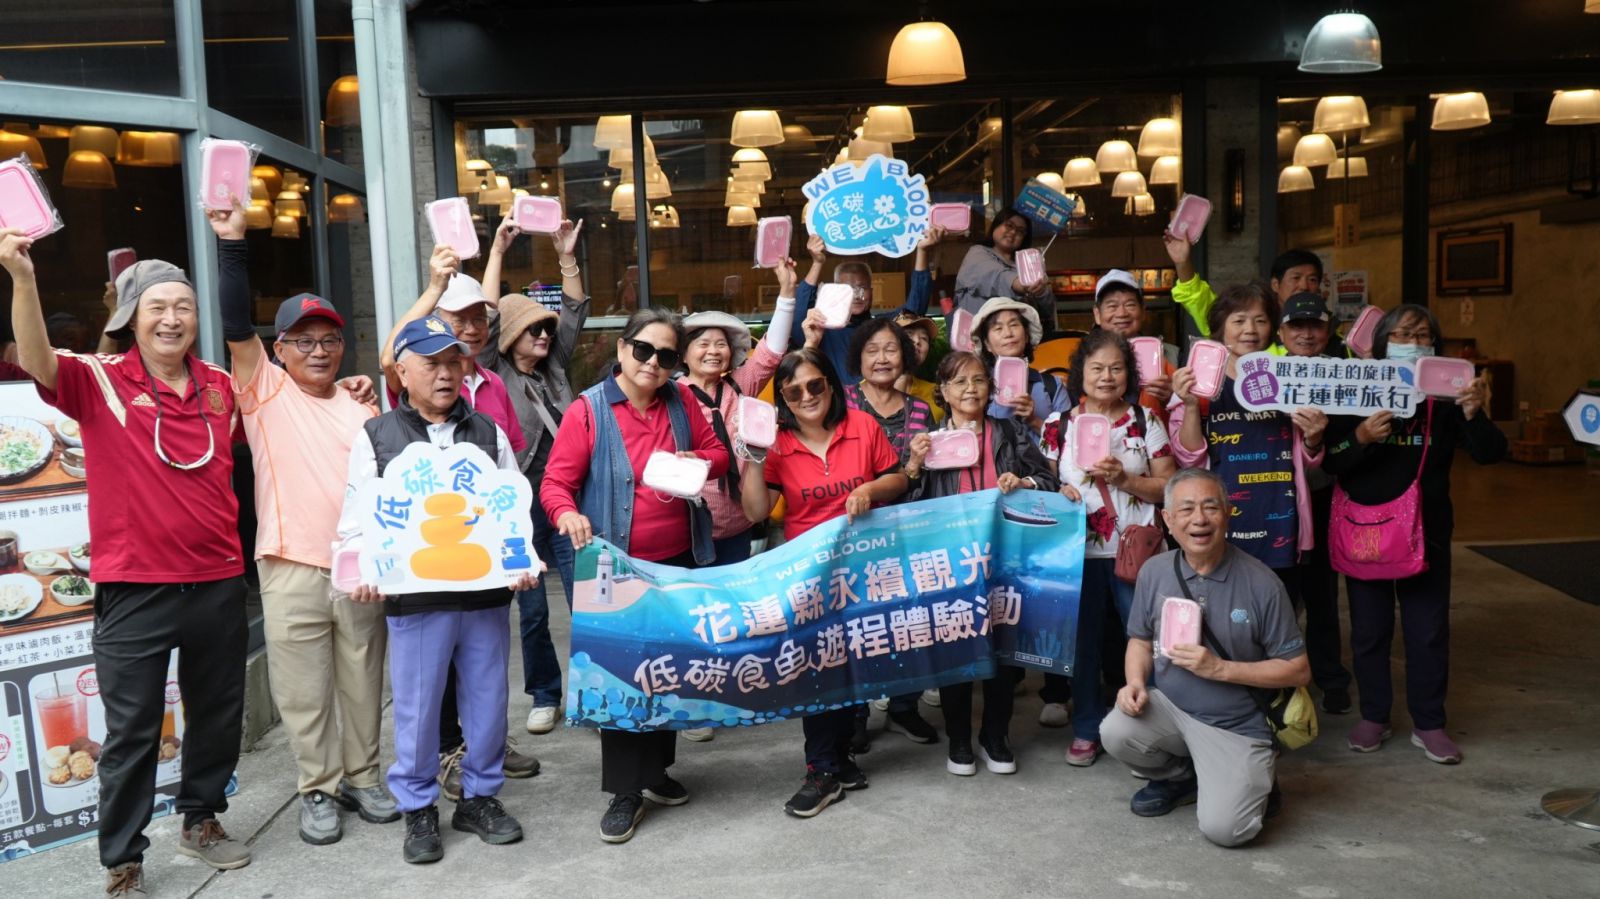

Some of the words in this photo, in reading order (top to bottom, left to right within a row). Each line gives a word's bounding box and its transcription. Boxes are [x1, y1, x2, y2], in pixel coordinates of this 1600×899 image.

[807, 166, 854, 199] WE
[886, 162, 927, 250] BLOOM!
[818, 191, 865, 220] 低碳
[824, 214, 876, 242] 食魚
[1242, 358, 1269, 374] 樂齡
[1276, 362, 1395, 381] 跟著海走的旋律
[1283, 382, 1410, 409] 花蓮輕旅行
[1211, 412, 1241, 423] LOVE
[1244, 411, 1278, 422] WHAT
[801, 477, 865, 502] FOUND
[1240, 473, 1290, 482] WEEKEND
[1232, 530, 1268, 540] AMERICA
[776, 560, 811, 581] WE
[816, 533, 895, 565] BLOOM!
[689, 542, 993, 644] 花蓮縣永續觀光
